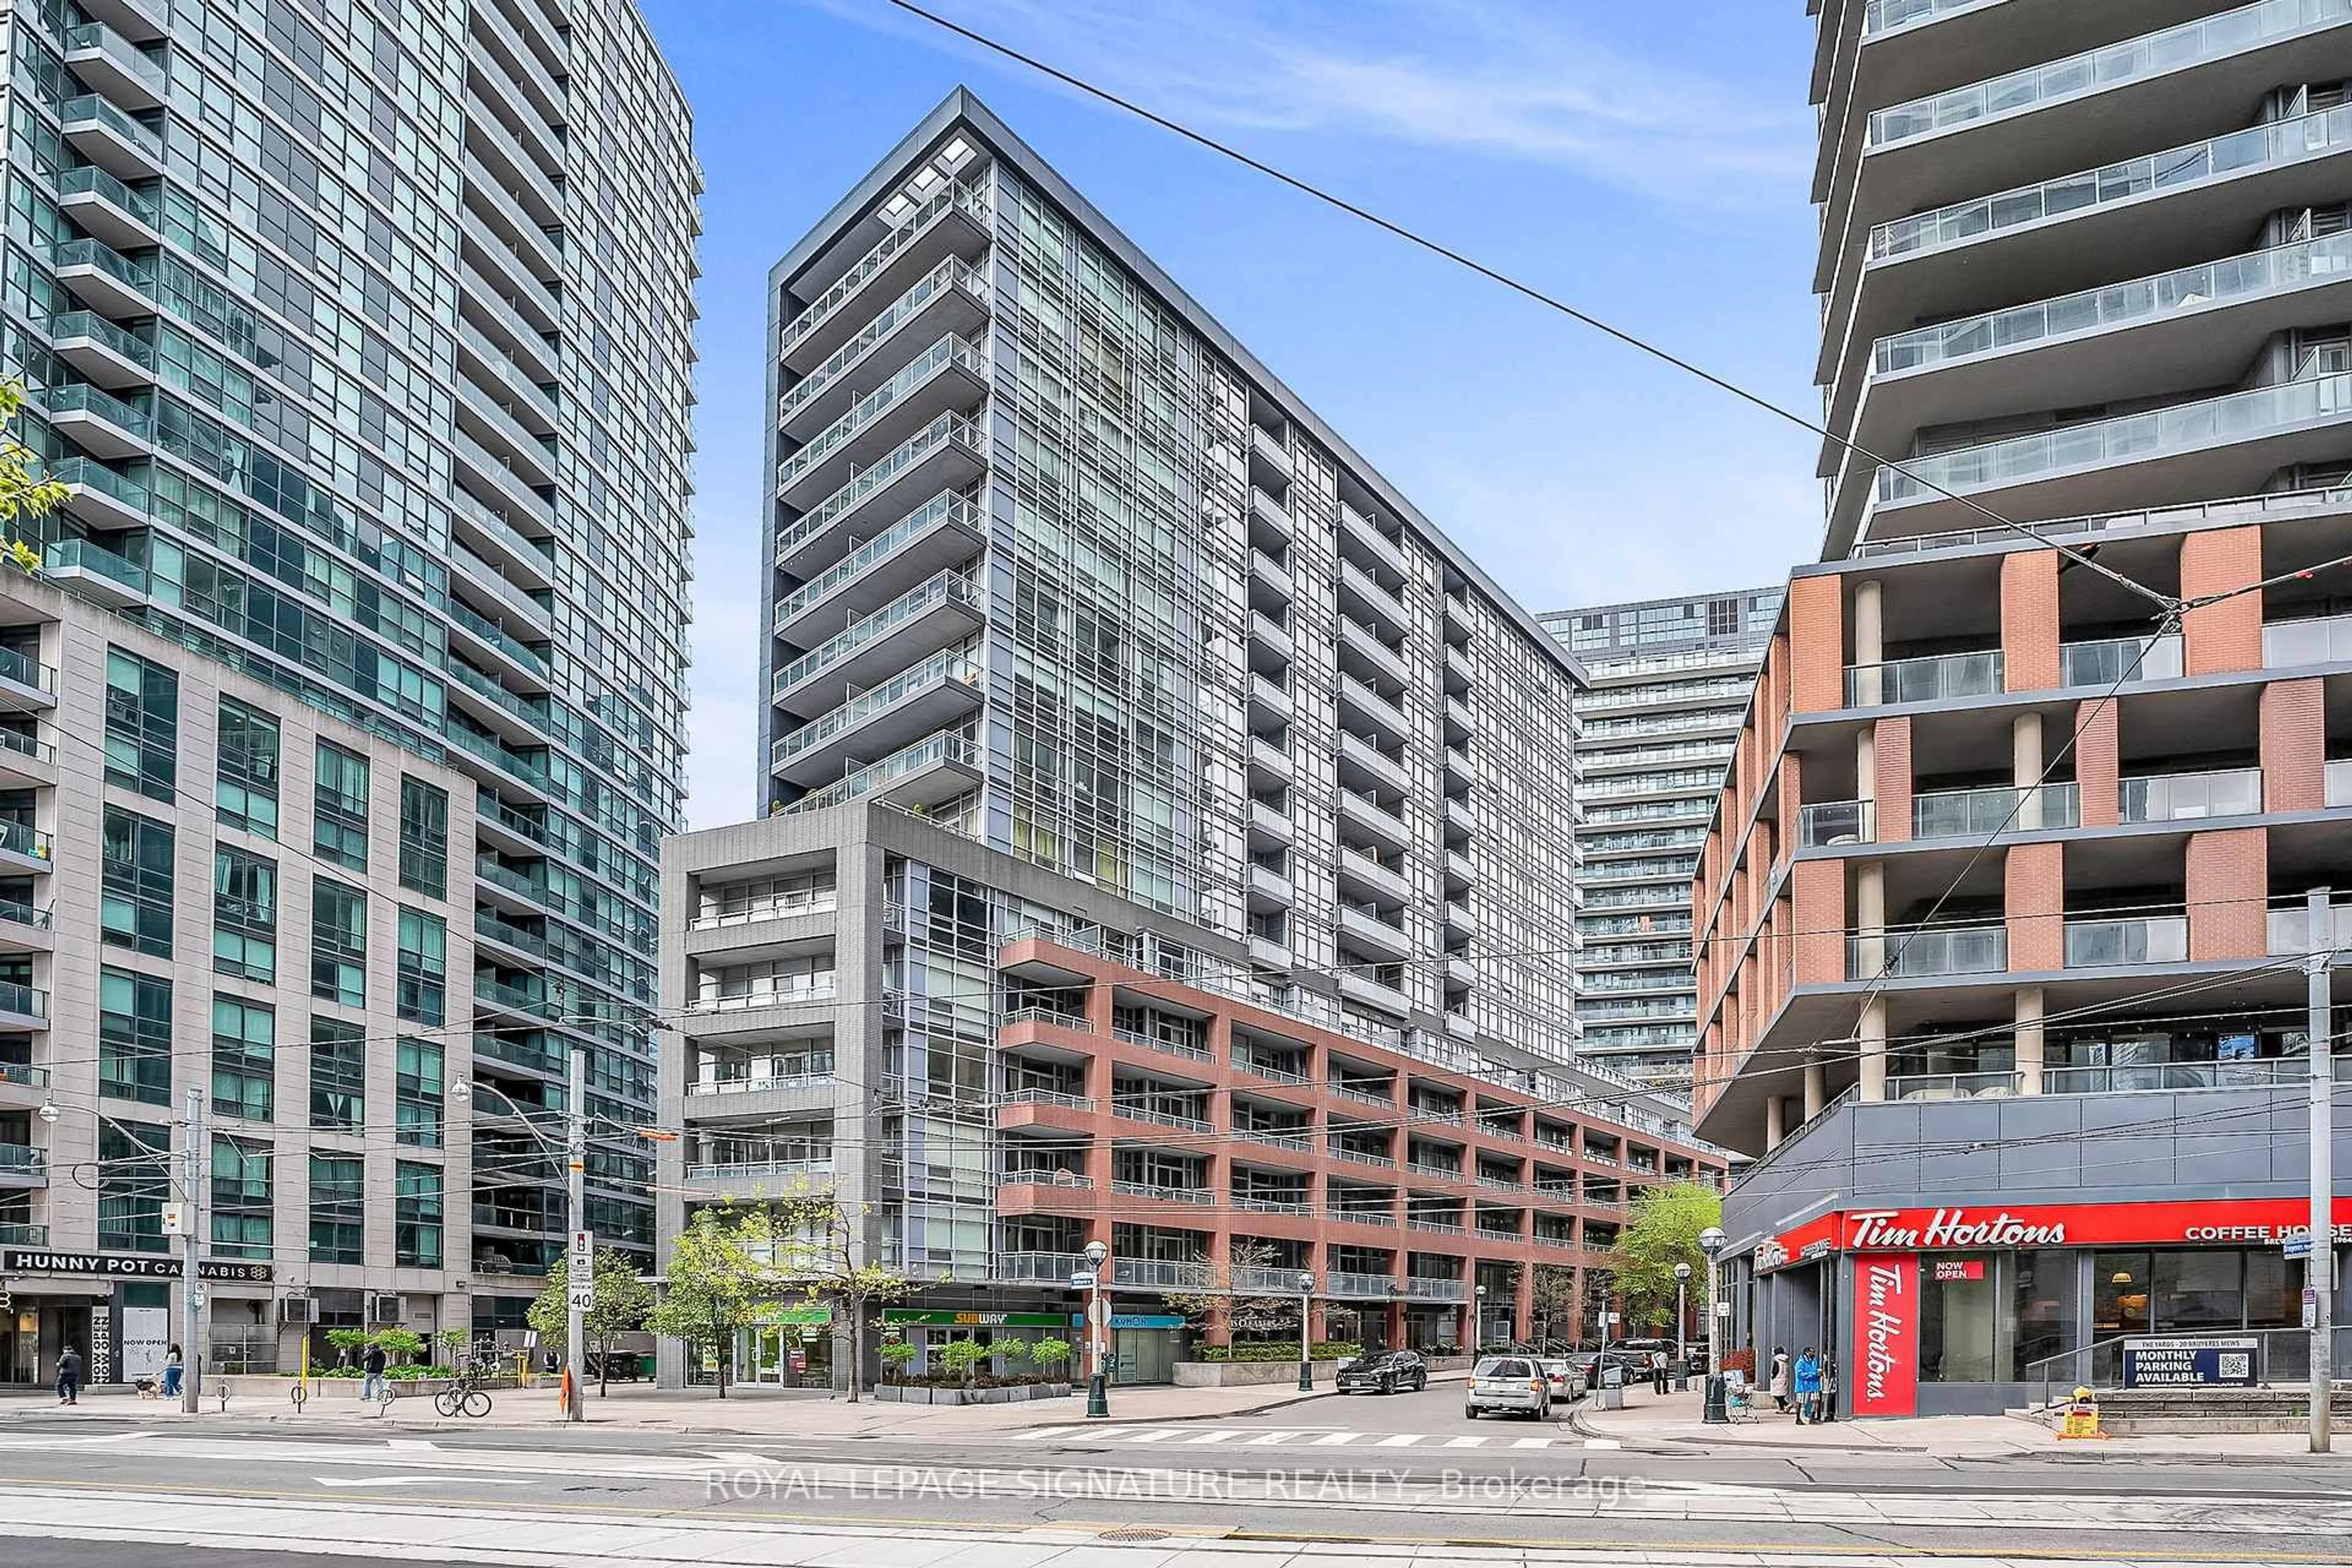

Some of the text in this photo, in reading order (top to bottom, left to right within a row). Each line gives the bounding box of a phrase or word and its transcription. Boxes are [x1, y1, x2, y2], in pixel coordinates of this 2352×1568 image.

[1850, 1208, 2065, 1248] Tim Hortons
[2185, 1224, 2352, 1240] COFFEE HOSE
[16, 1254, 246, 1278] HUNNY POT CANABIS
[1869, 1264, 1902, 1306] Tim
[571, 1294, 591, 1308] 40
[954, 1313, 1007, 1324] SUBWAY
[2135, 1351, 2197, 1360] MONTHLY
[2135, 1361, 2192, 1371] PARKING
[2135, 1372, 2204, 1382] AVAILABLE
